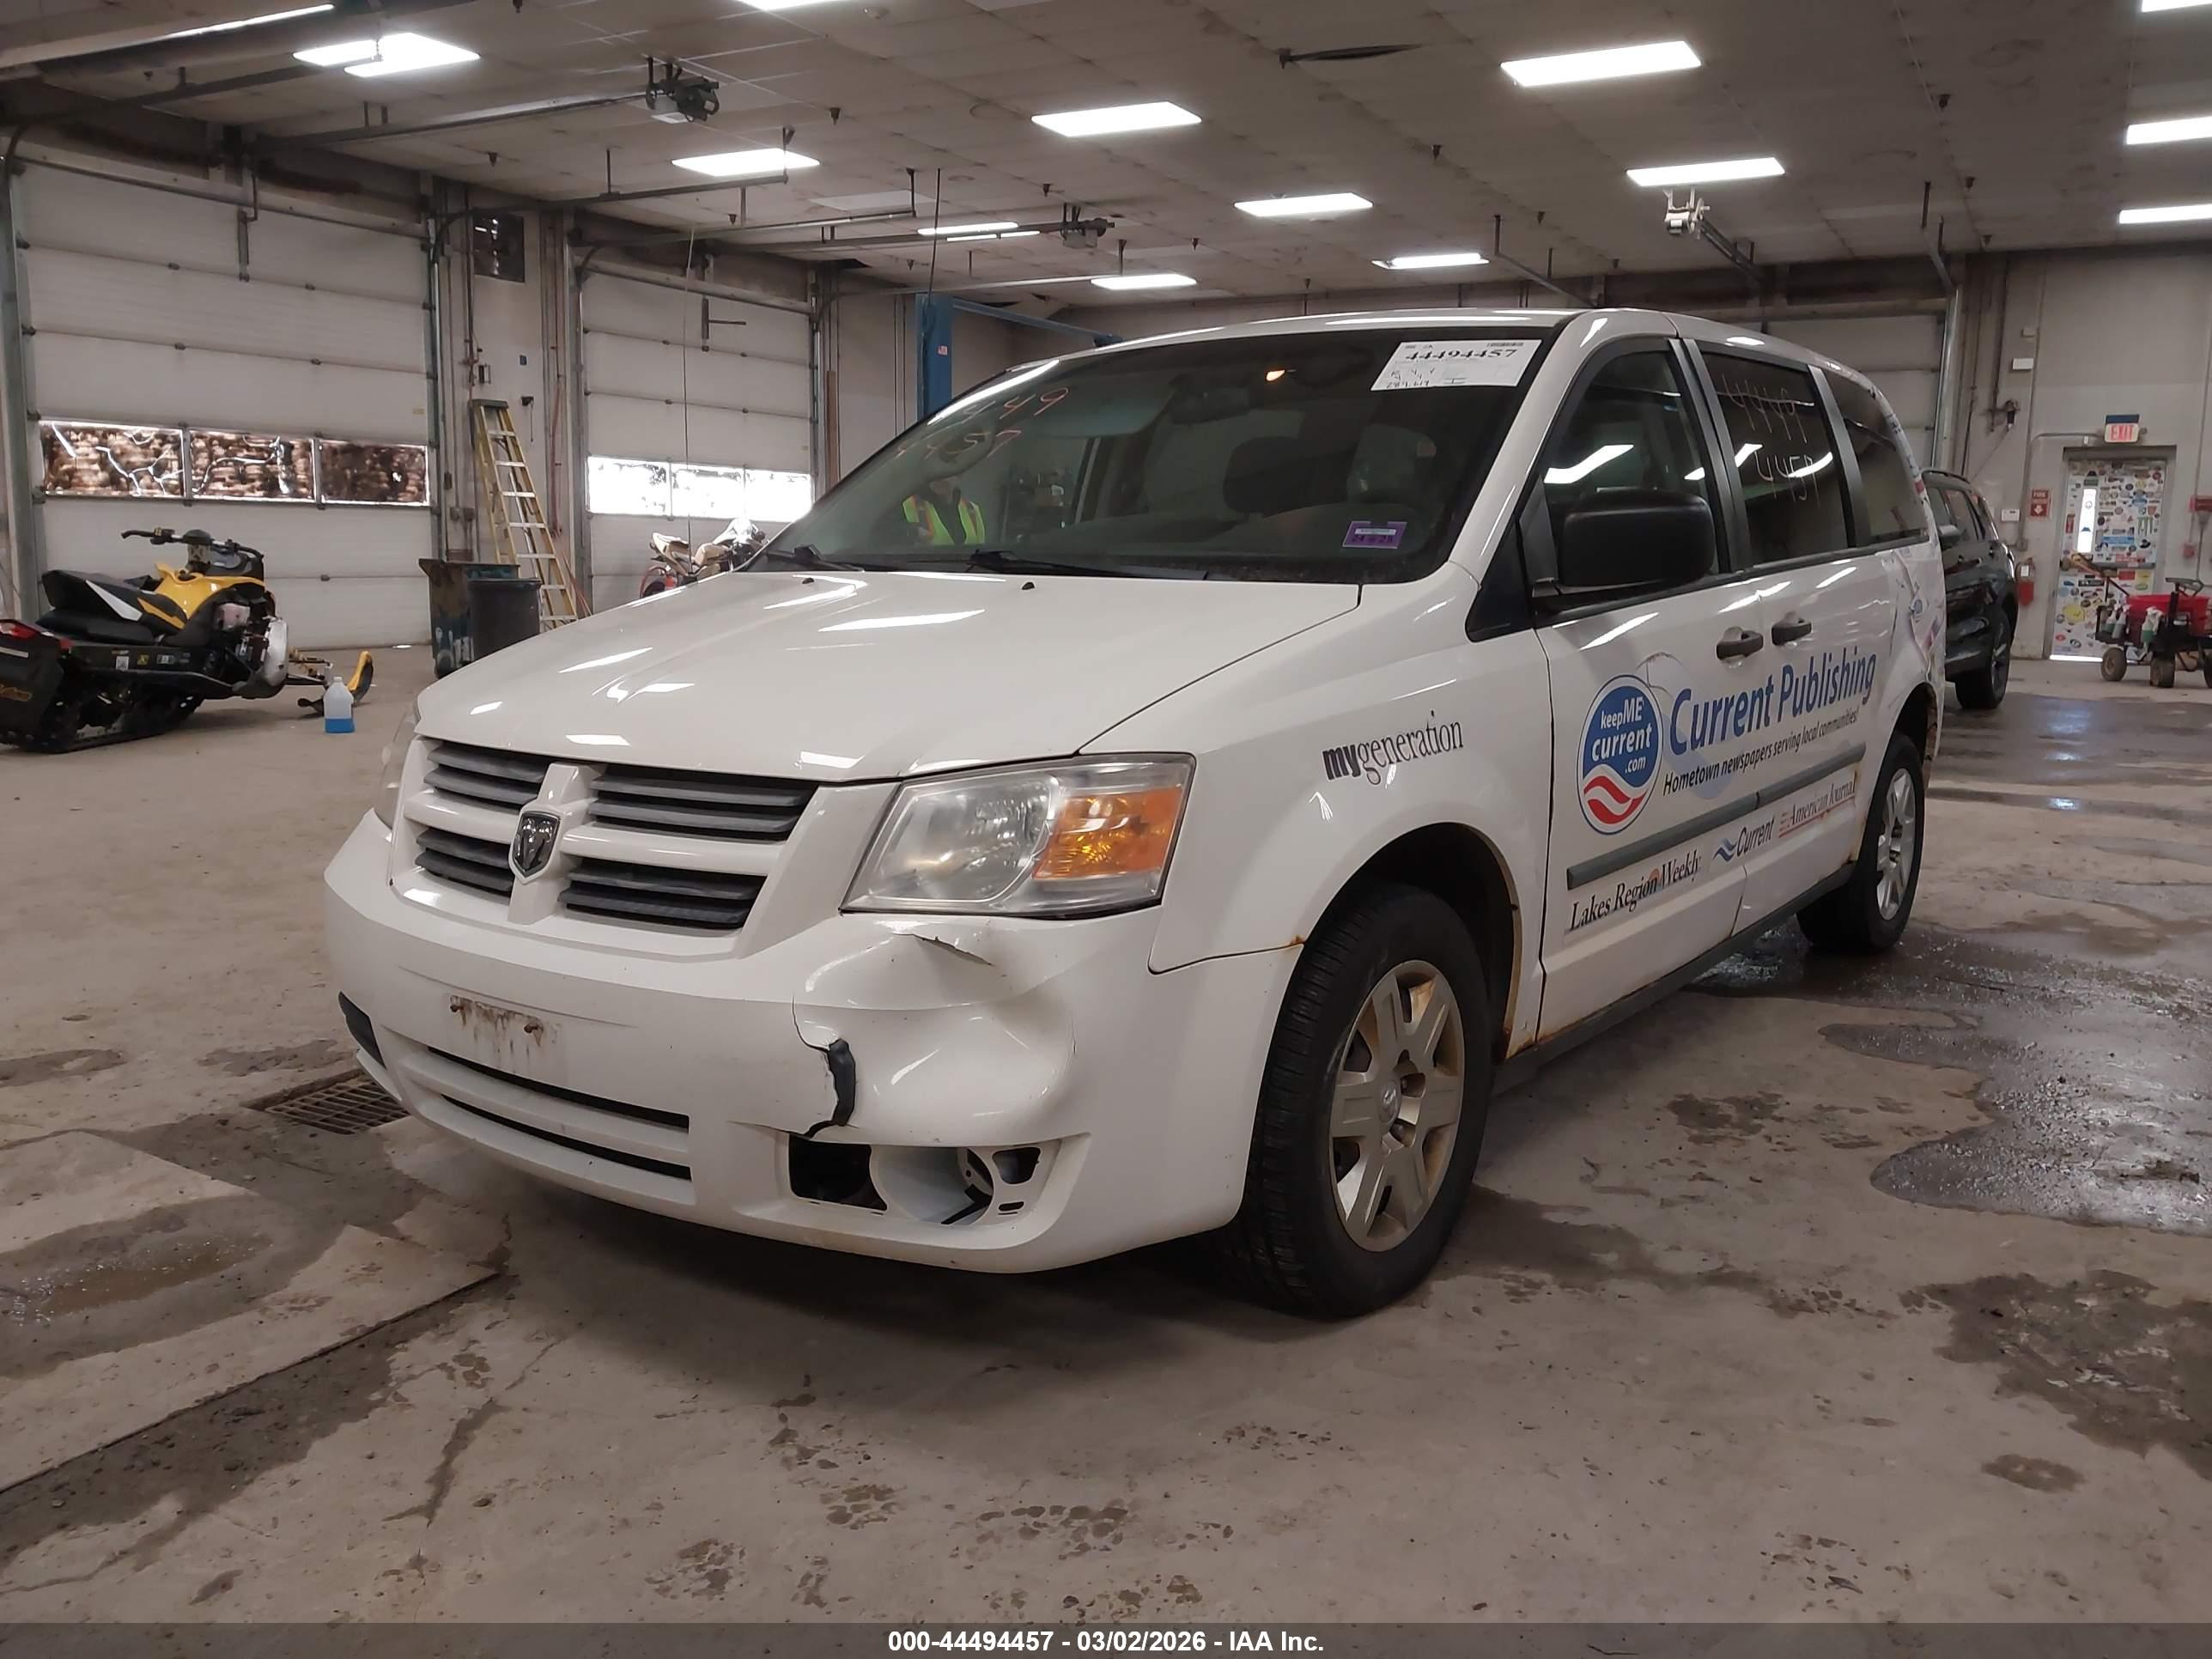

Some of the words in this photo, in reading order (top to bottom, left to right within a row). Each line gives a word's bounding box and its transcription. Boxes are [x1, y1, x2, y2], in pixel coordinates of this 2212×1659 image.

[1406, 349, 1517, 361] 44494457
[2110, 424, 2133, 441] EXIT
[1670, 674, 1774, 755] Current
[1778, 646, 1877, 722] Publishing
[1322, 709, 1463, 786] mygeneration
[1592, 723, 1652, 762] current
[1663, 762, 1720, 796] Hometown
[1721, 744, 1773, 773] newspapers
[1773, 732, 1802, 757] serving
[1801, 720, 1819, 745] local
[1625, 756, 1647, 773] .com
[1790, 793, 1828, 824] American
[1829, 780, 1856, 804] Journal
[1737, 816, 1775, 856] Current
[1570, 894, 1611, 931] Lakes
[1614, 876, 1658, 912] Region
[1662, 848, 1701, 889] Weekly
